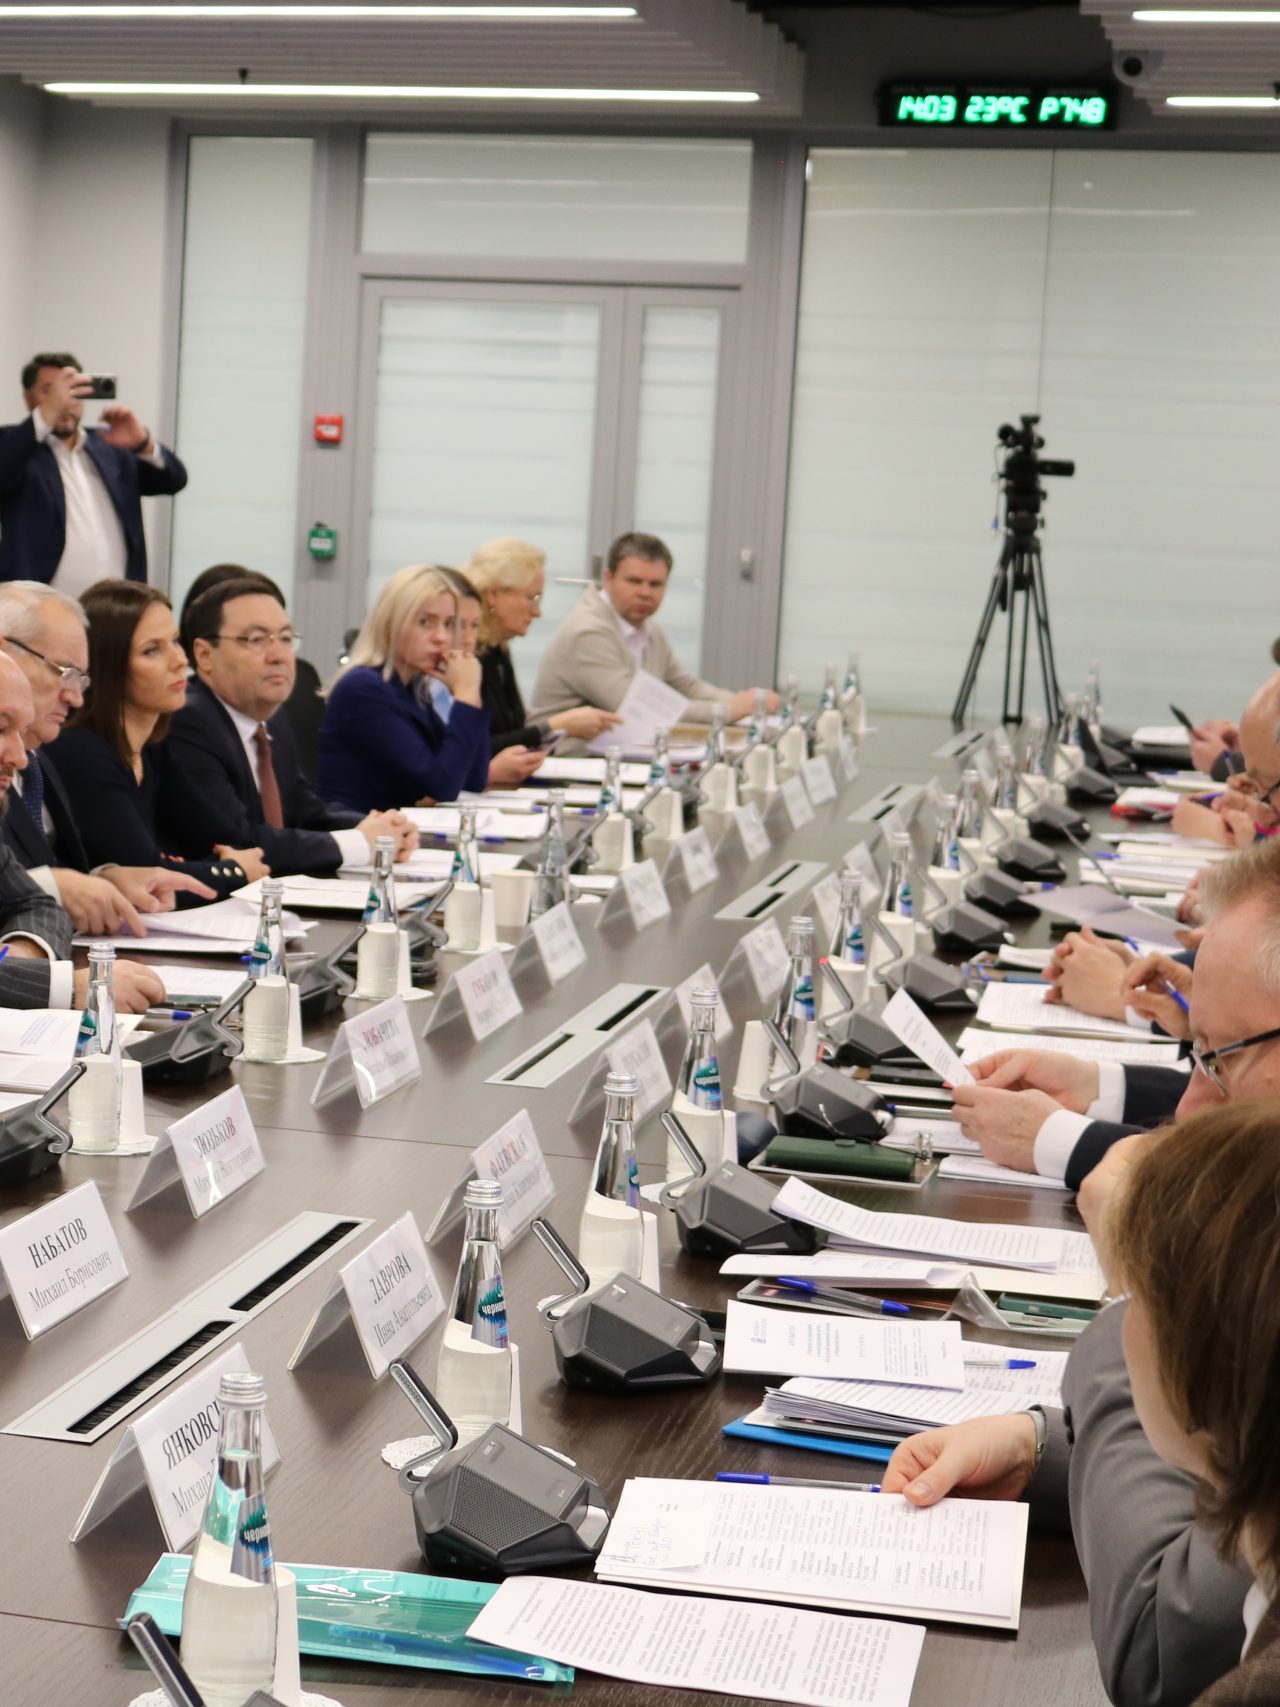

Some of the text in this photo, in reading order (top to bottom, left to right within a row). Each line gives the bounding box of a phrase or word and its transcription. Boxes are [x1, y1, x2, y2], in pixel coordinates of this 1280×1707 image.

[193, 1115, 236, 1159] ЗЮЗЬКОВ
[28, 1217, 87, 1269] НАБАТОВ
[28, 1250, 112, 1312] Михаил Борисович
[369, 1249, 412, 1305] ЛАВРОВА
